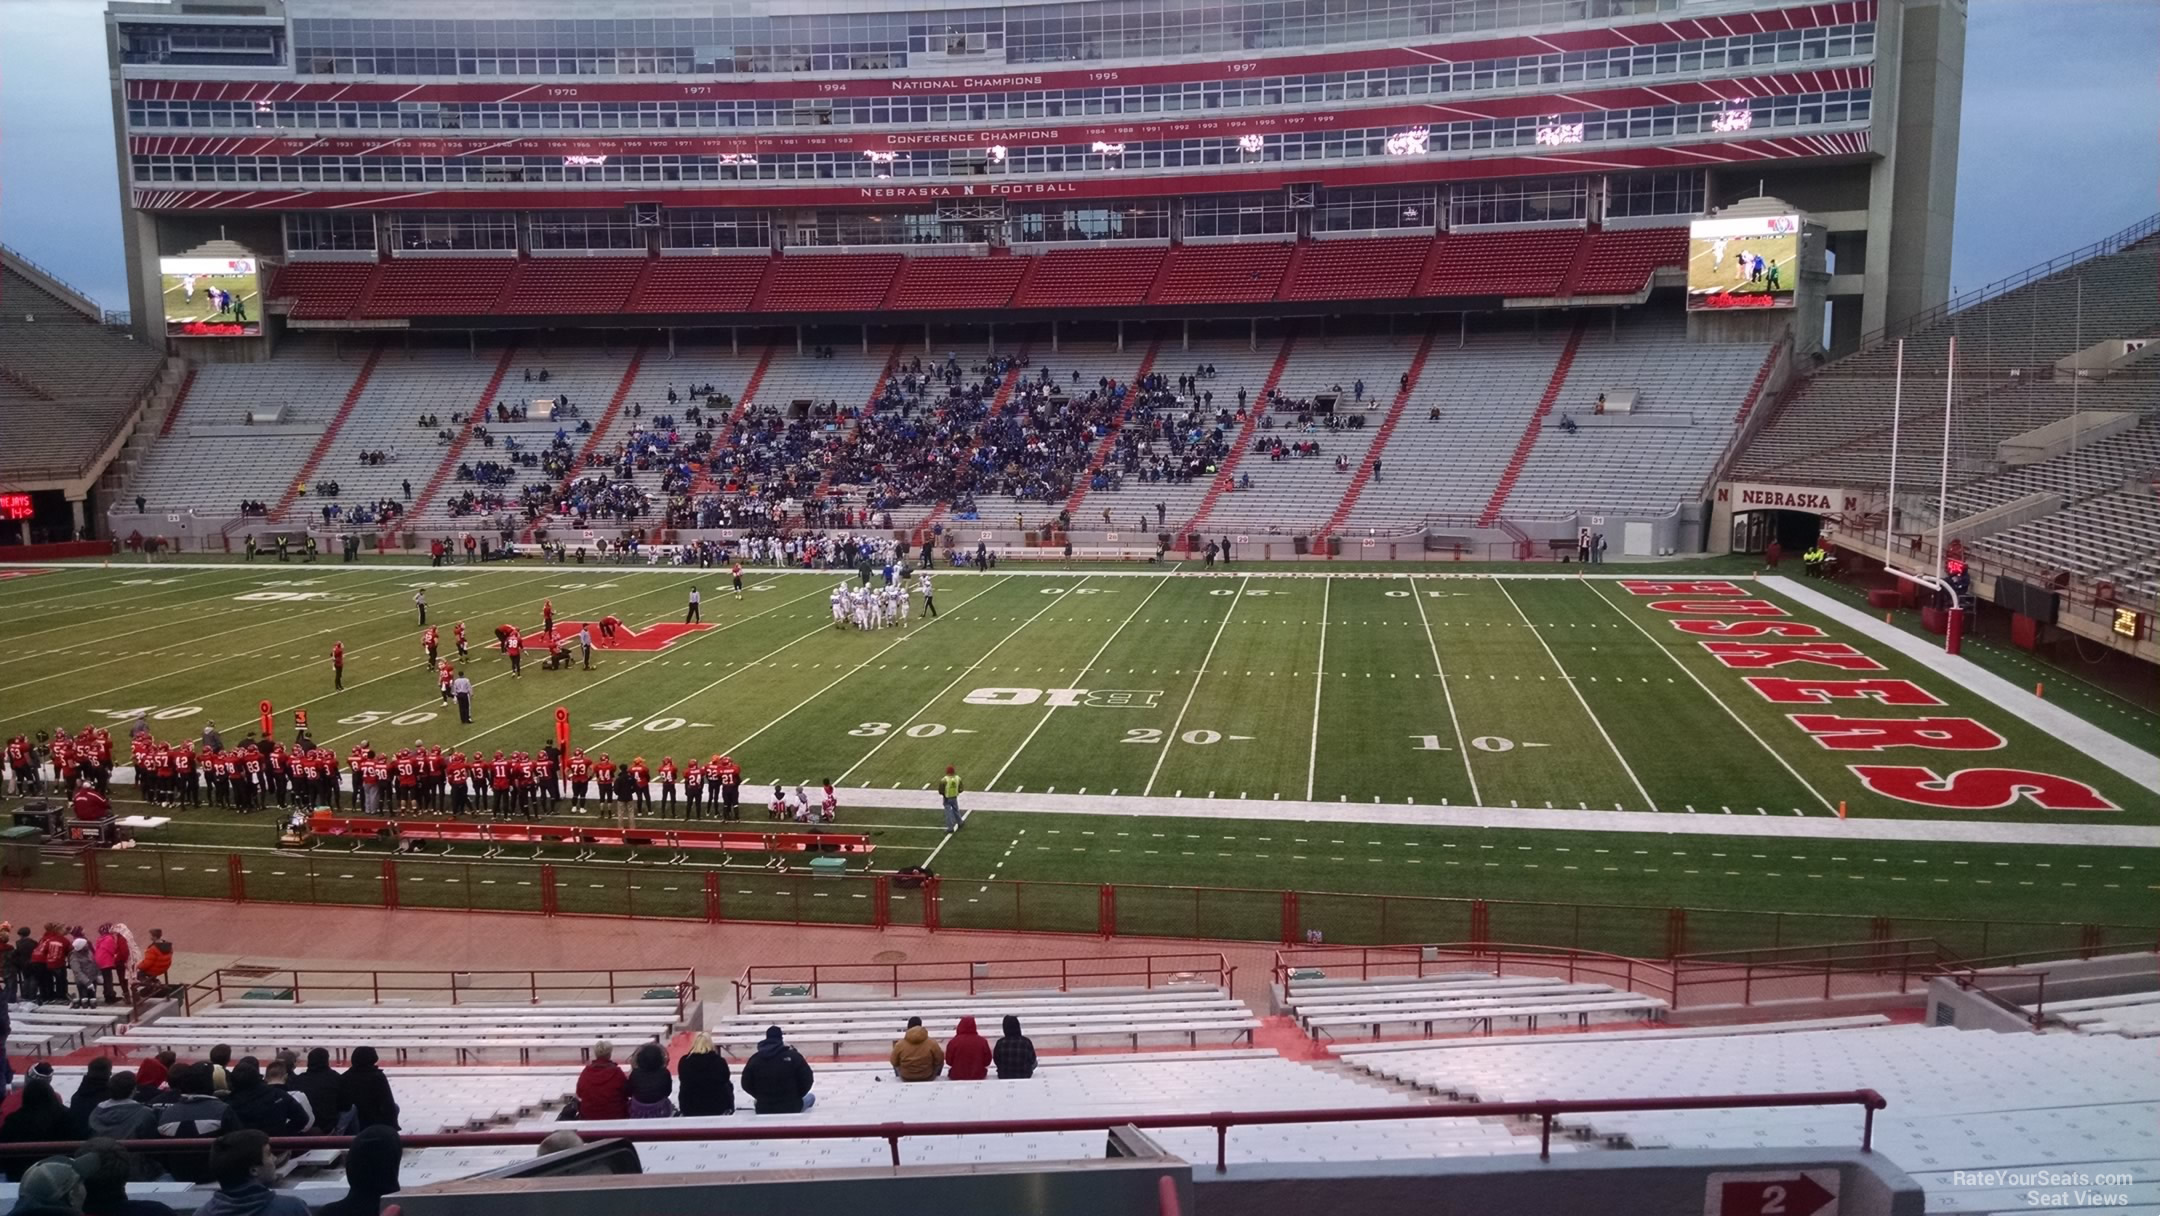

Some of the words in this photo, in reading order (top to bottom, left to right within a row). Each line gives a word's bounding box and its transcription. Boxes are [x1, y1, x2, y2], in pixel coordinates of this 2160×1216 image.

[892, 80, 958, 90] NATIONAL
[964, 76, 1042, 87] CHAMPIONS
[1089, 72, 1118, 80] 1995
[1227, 64, 1256, 72] 1997
[887, 134, 974, 144] CONFERENCE
[981, 131, 1058, 141] CHAMPIONS
[861, 187, 950, 197] NEBRASKA
[964, 186, 973, 195] N
[990, 184, 1076, 194] FOOTBALL
[1718, 489, 1729, 501] N
[1743, 490, 1830, 509] NEBRASKA
[1845, 497, 1856, 511] N
[1616, 580, 2124, 812] HUSKERS
[295, 711, 306, 722] 3
[336, 711, 438, 726] 50
[589, 717, 686, 732] 40
[848, 721, 947, 738] 30
[1120, 728, 1222, 746] 20
[1410, 735, 1516, 753] 10
[155, 756, 168, 767] 57
[246, 761, 260, 772] 83
[418, 761, 425, 772] 7
[361, 766, 375, 777] 79
[398, 764, 413, 775] 50
[495, 766, 505, 778] 11
[523, 766, 531, 778] 5
[571, 764, 586, 775] 73
[721, 774, 735, 785] 21
[1760, 1185, 1787, 1214] 2
